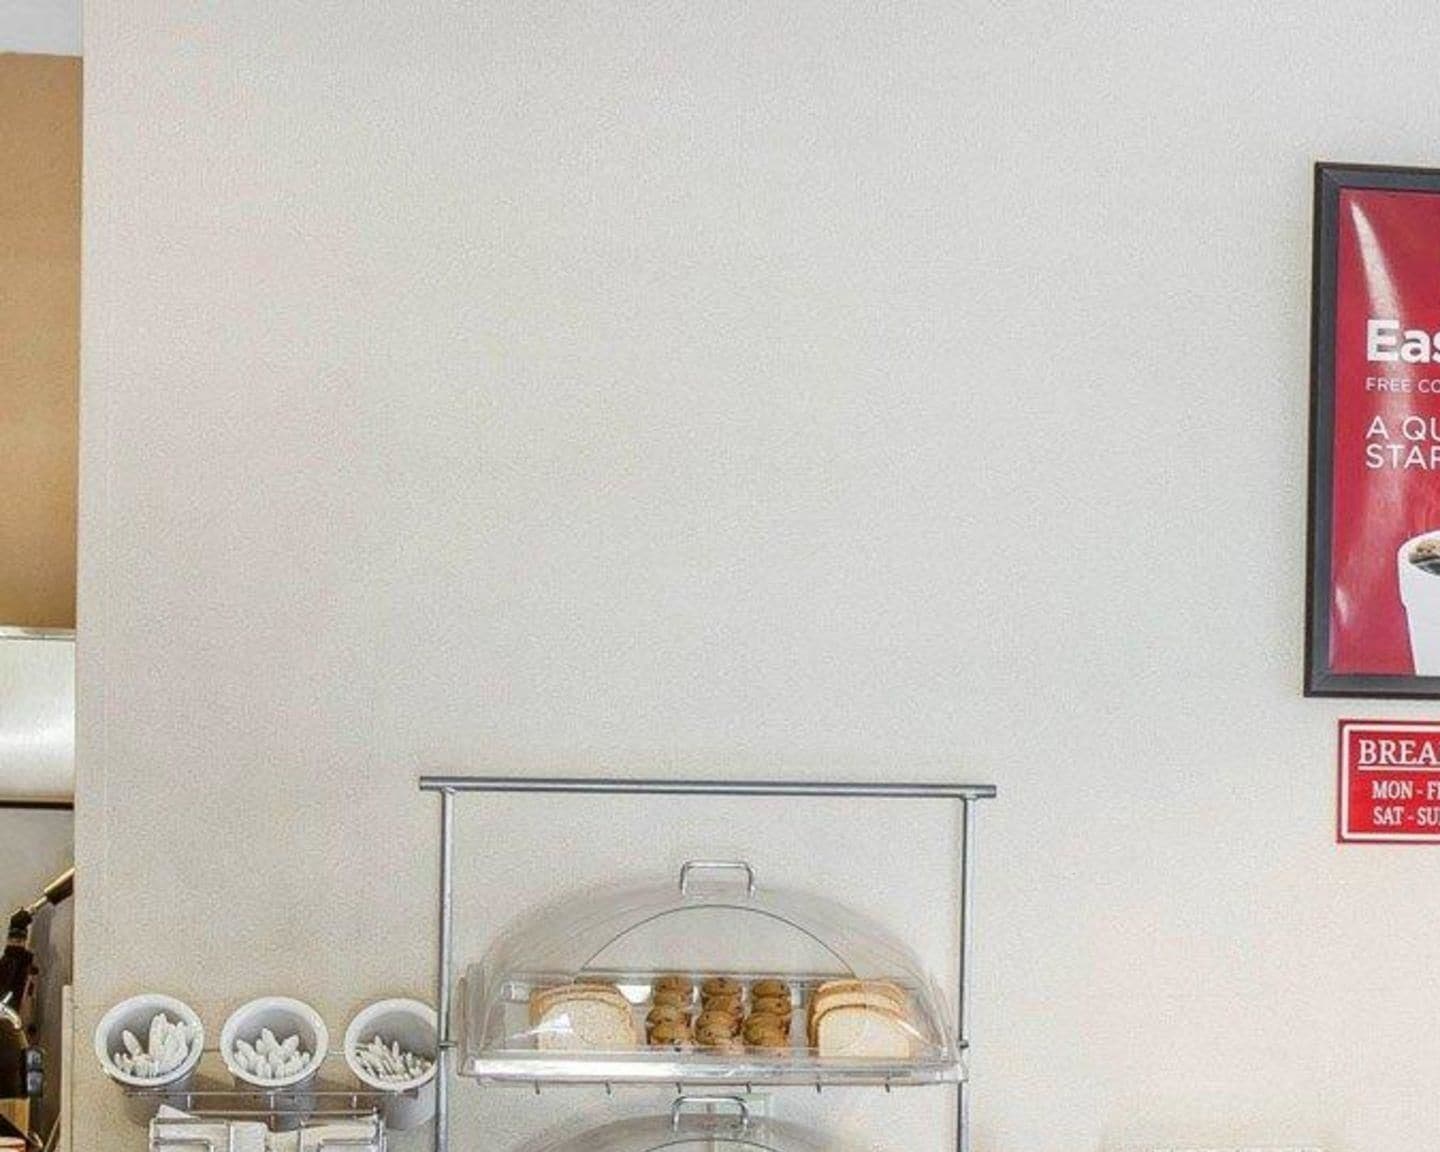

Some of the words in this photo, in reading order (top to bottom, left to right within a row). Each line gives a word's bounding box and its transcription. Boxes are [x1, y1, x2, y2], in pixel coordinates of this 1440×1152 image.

[1366, 378, 1410, 393] FREE
[1366, 416, 1391, 439] A
[1372, 780, 1414, 800] MON
[1373, 807, 1404, 825] SAT
